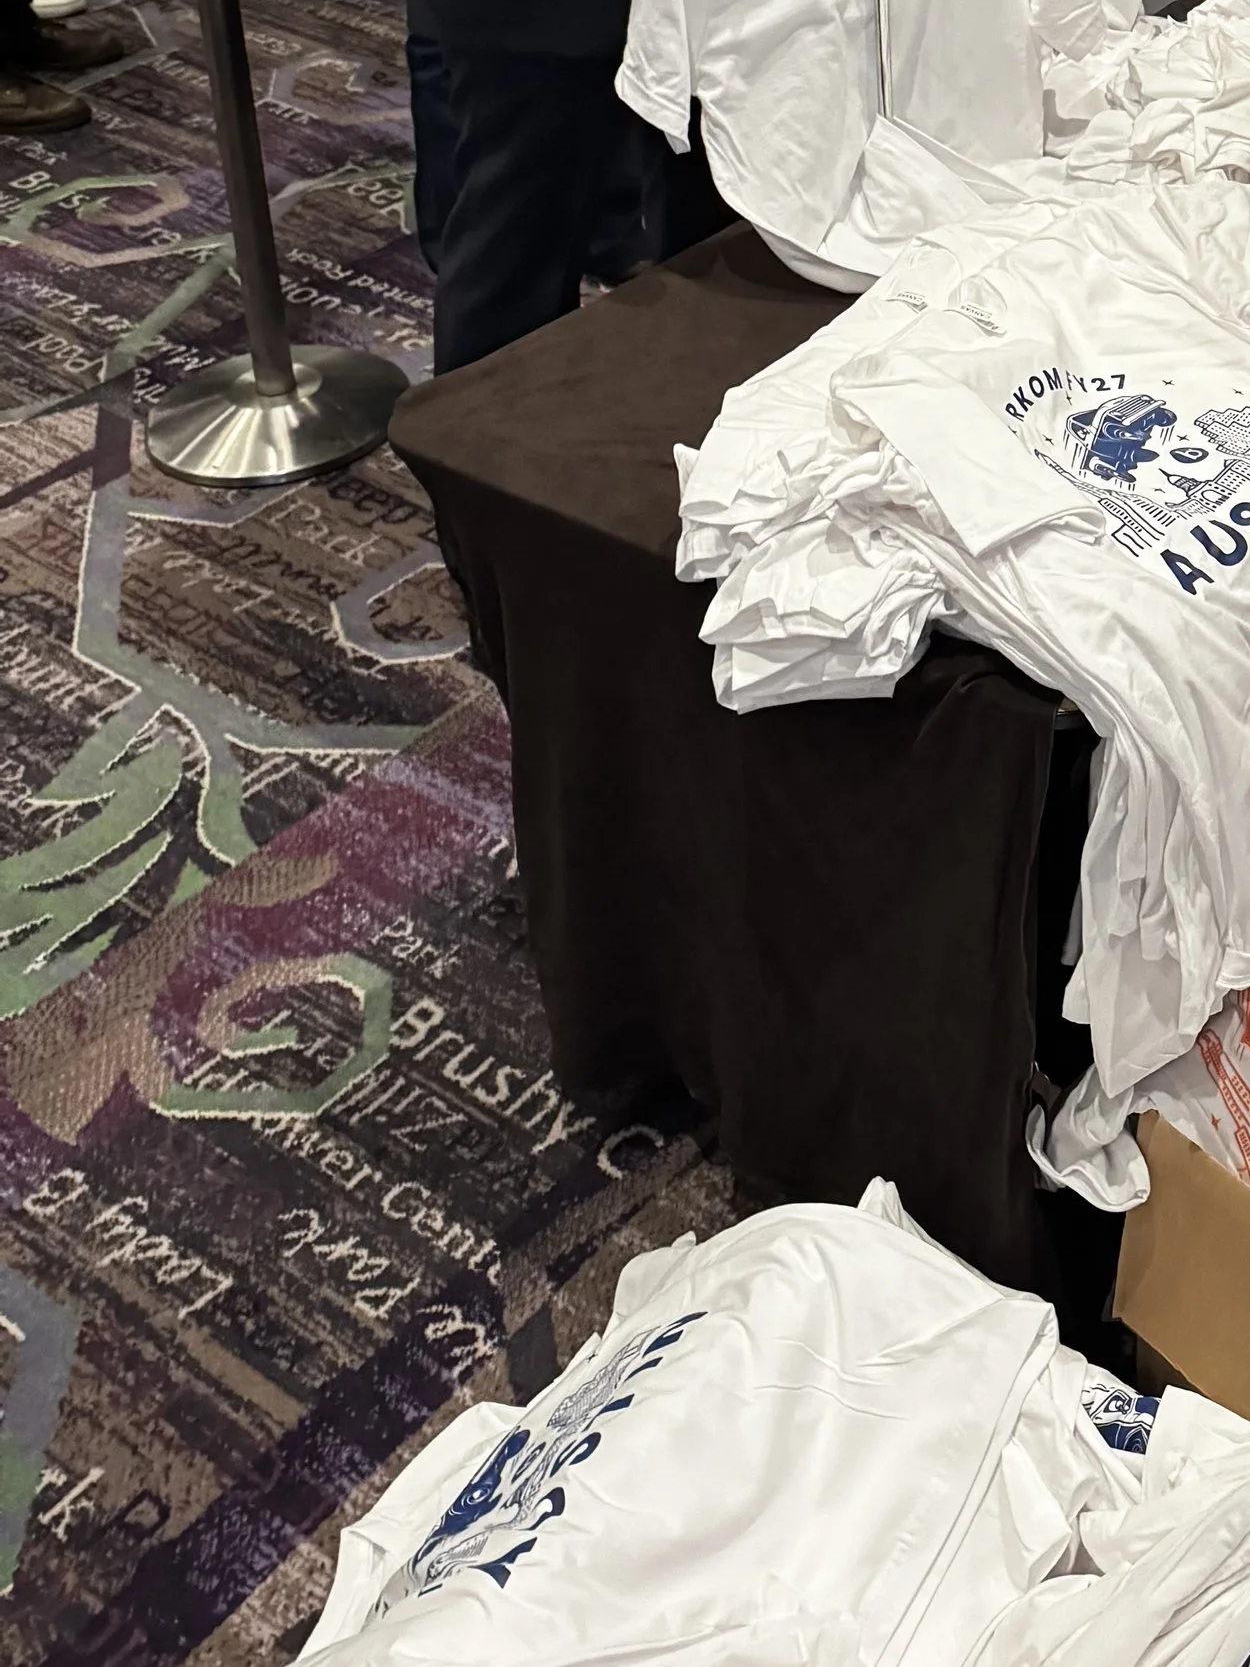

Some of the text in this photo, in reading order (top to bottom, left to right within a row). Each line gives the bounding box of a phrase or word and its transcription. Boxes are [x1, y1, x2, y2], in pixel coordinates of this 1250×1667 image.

[388, 996, 598, 1156] Brushy
[84, 1194, 236, 1320] Lady
[278, 1207, 423, 1321] Park
